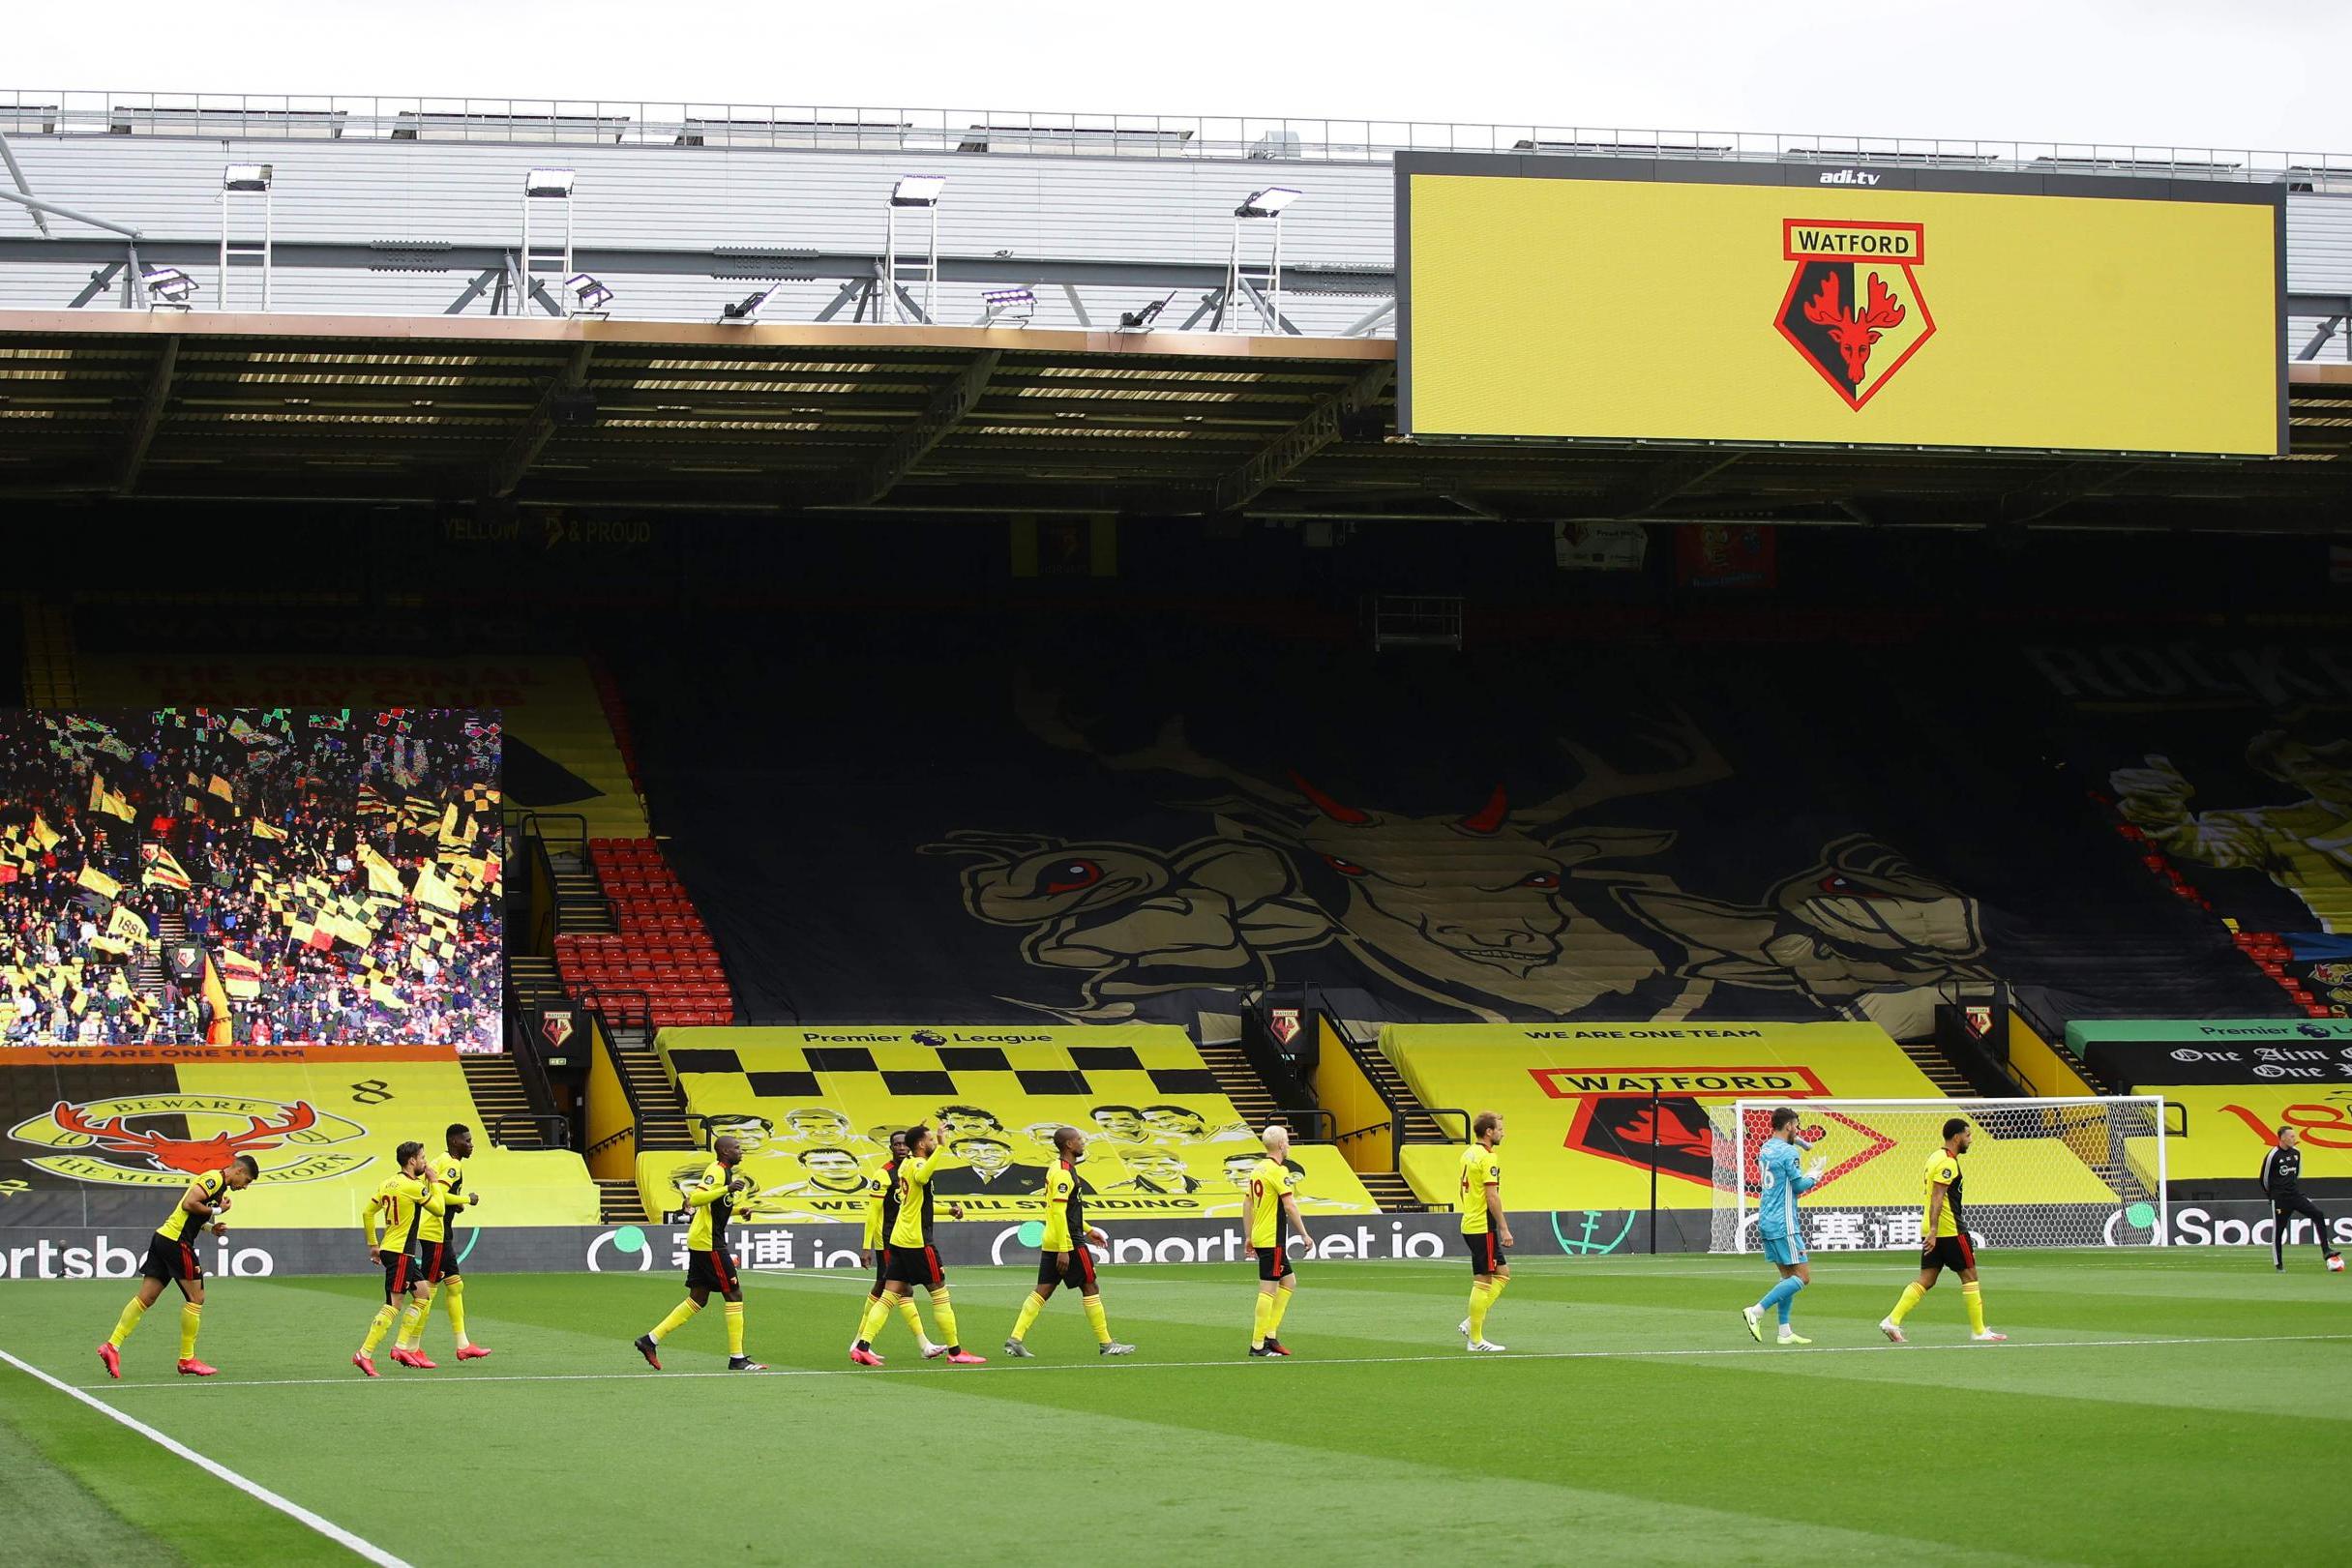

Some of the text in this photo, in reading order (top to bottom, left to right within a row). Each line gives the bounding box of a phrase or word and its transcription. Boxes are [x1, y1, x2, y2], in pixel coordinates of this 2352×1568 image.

[1820, 169, 1881, 185] adi.tv
[1799, 230, 1909, 253] WATFORD
[586, 521, 651, 542] PROUD
[117, 915, 142, 938] 1881
[1525, 1029, 1763, 1040] WE ARE ONE TEAM
[2200, 1025, 2289, 1036] Premier
[803, 1033, 1053, 1044] Premier League
[46, 1049, 306, 1059] WE ARE ONE TEAM
[2169, 1048, 2245, 1062] One
[2252, 1047, 2331, 1062] Aim
[2252, 1063, 2327, 1078] One
[1565, 1075, 1793, 1092] WATFORD
[112, 1099, 256, 1112] BEWARE
[1249, 1178, 1264, 1208] 19
[381, 1195, 399, 1226] 21
[1015, 1198, 1200, 1209] STNDING
[1083, 1221, 1444, 1263] Sportbet.io
